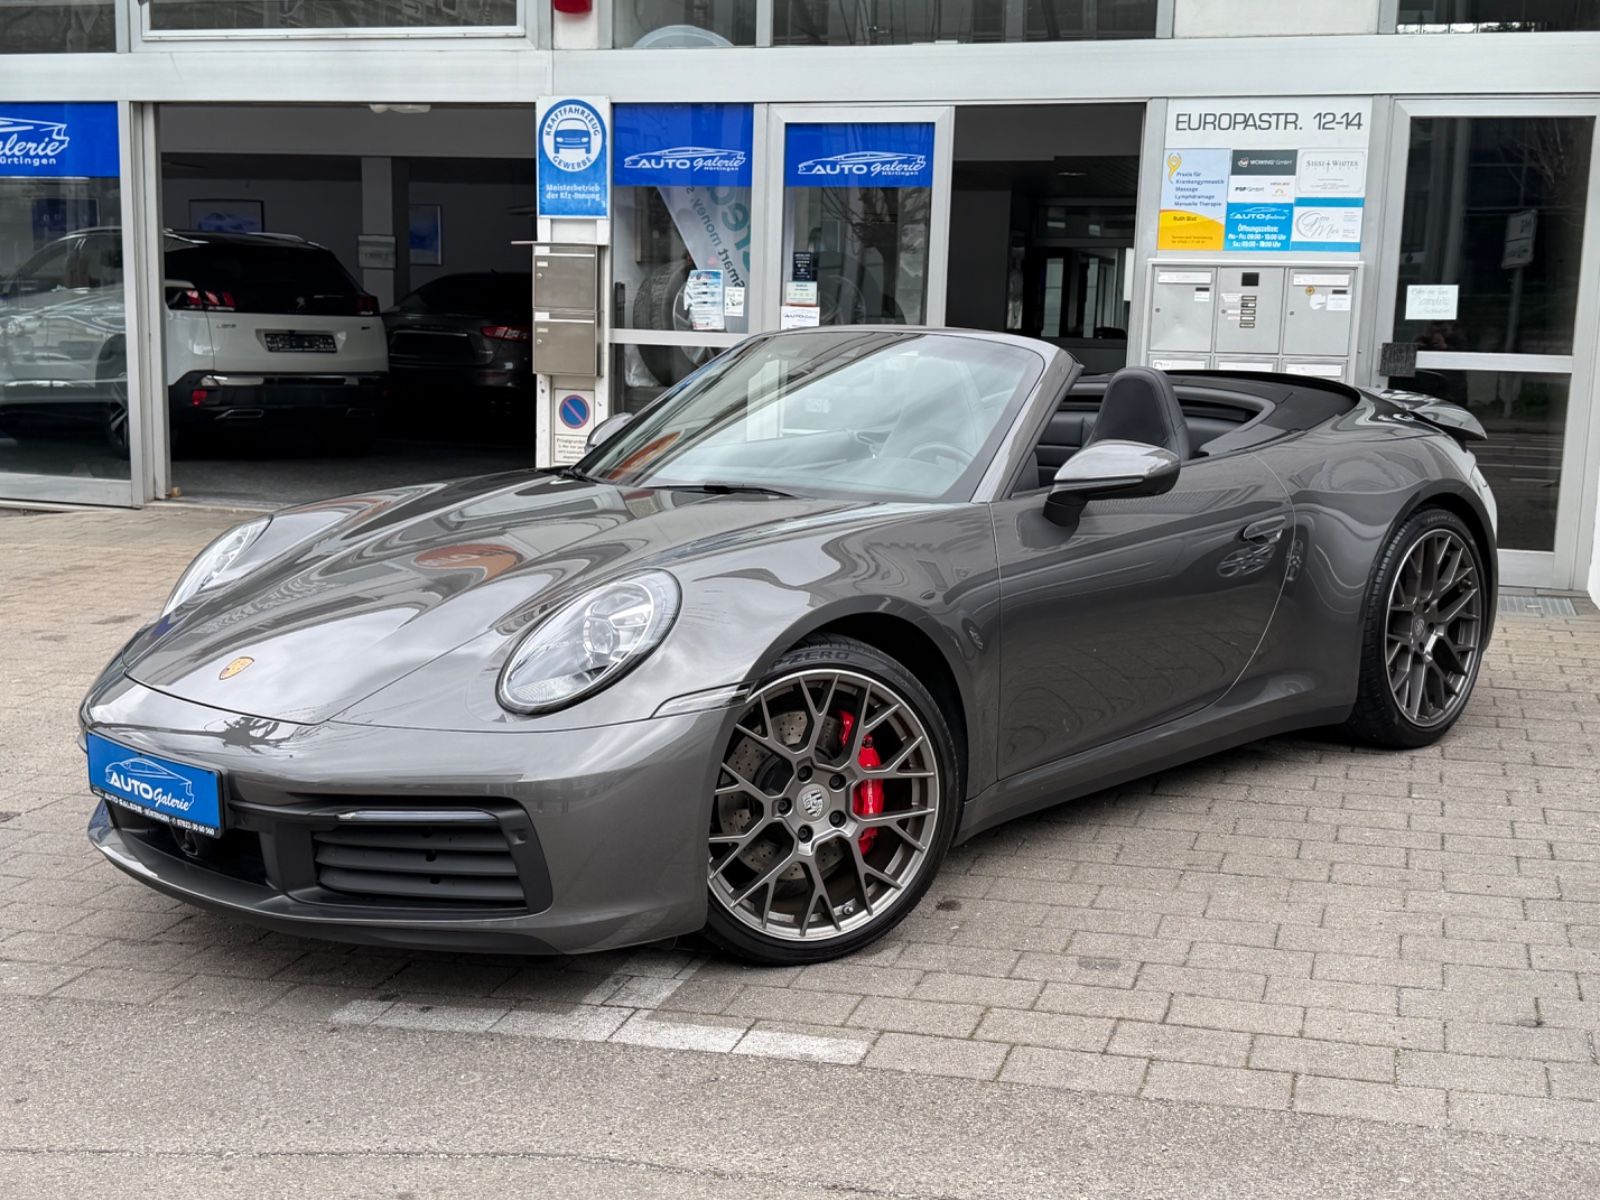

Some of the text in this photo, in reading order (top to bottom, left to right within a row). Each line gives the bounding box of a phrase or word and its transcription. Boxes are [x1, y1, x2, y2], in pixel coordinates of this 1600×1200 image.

[545, 106, 600, 136] KRAFTFAHRZEUG
[1175, 112, 1364, 131] EUROPASTR. 12-14
[552, 155, 592, 170] GEWERBE
[637, 158, 690, 169] AUTO
[812, 164, 868, 175] AUTO
[546, 184, 600, 192] Meisterbetrieb
[110, 772, 153, 800] AUTO
